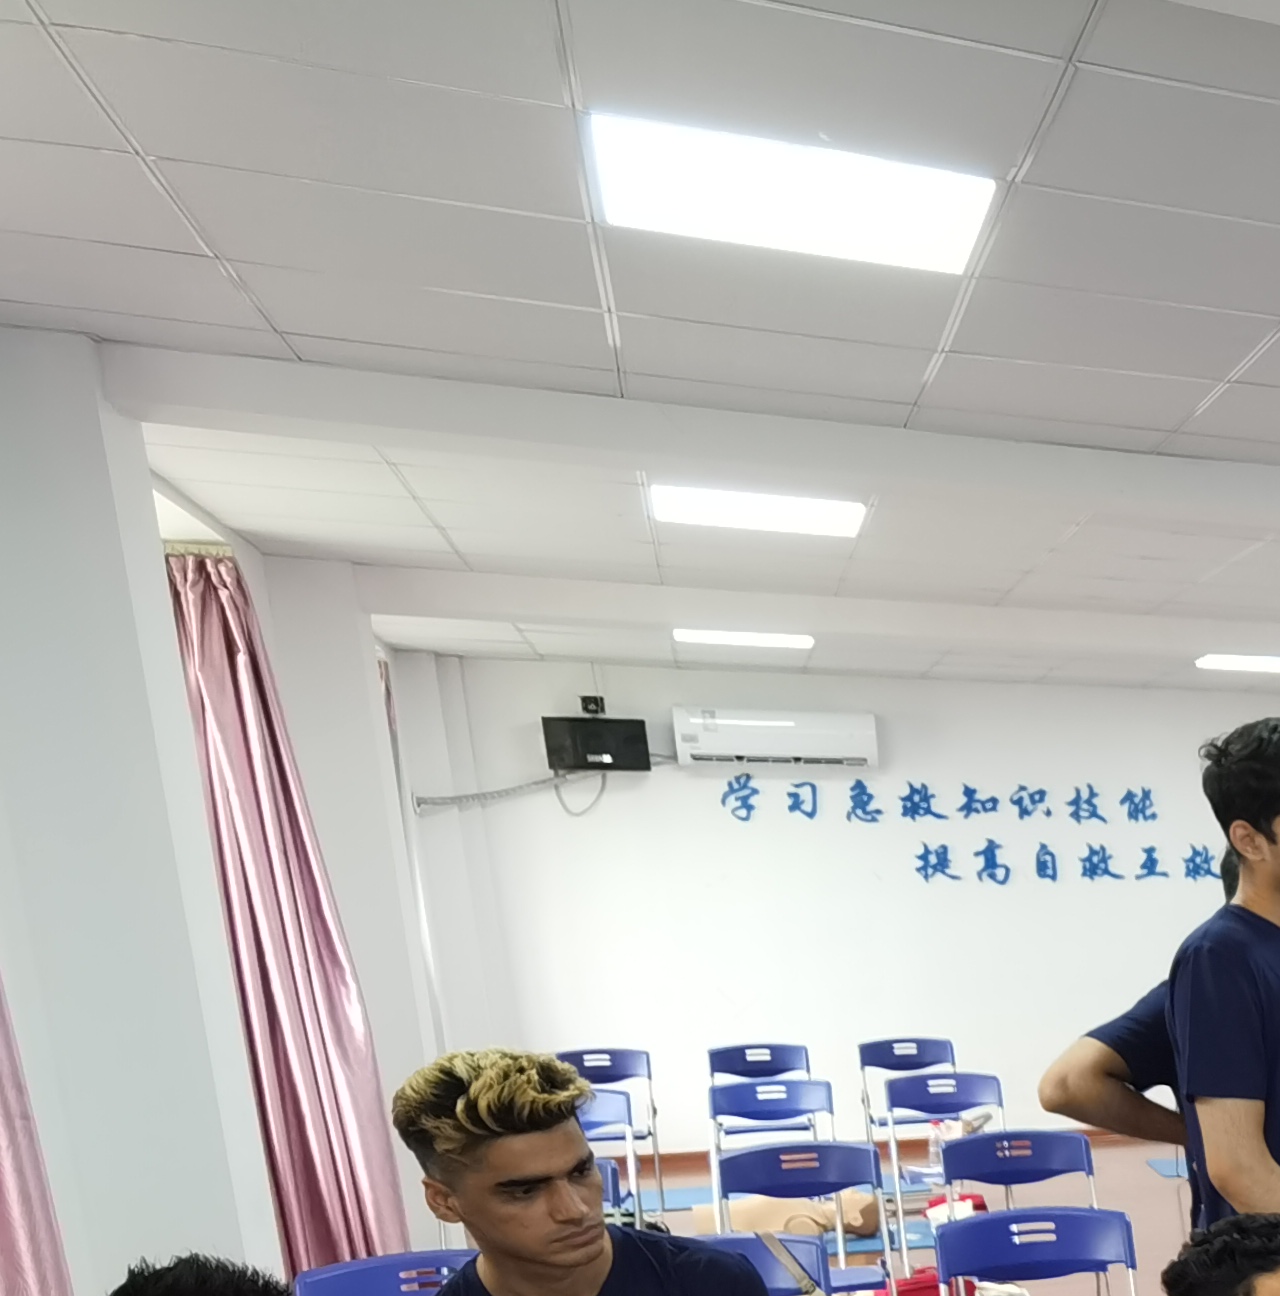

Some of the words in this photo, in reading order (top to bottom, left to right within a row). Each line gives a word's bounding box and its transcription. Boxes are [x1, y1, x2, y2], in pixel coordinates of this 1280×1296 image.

[722, 774, 1158, 823] 学习急救知识技能
[915, 839, 1223, 885] 提高自救互救
